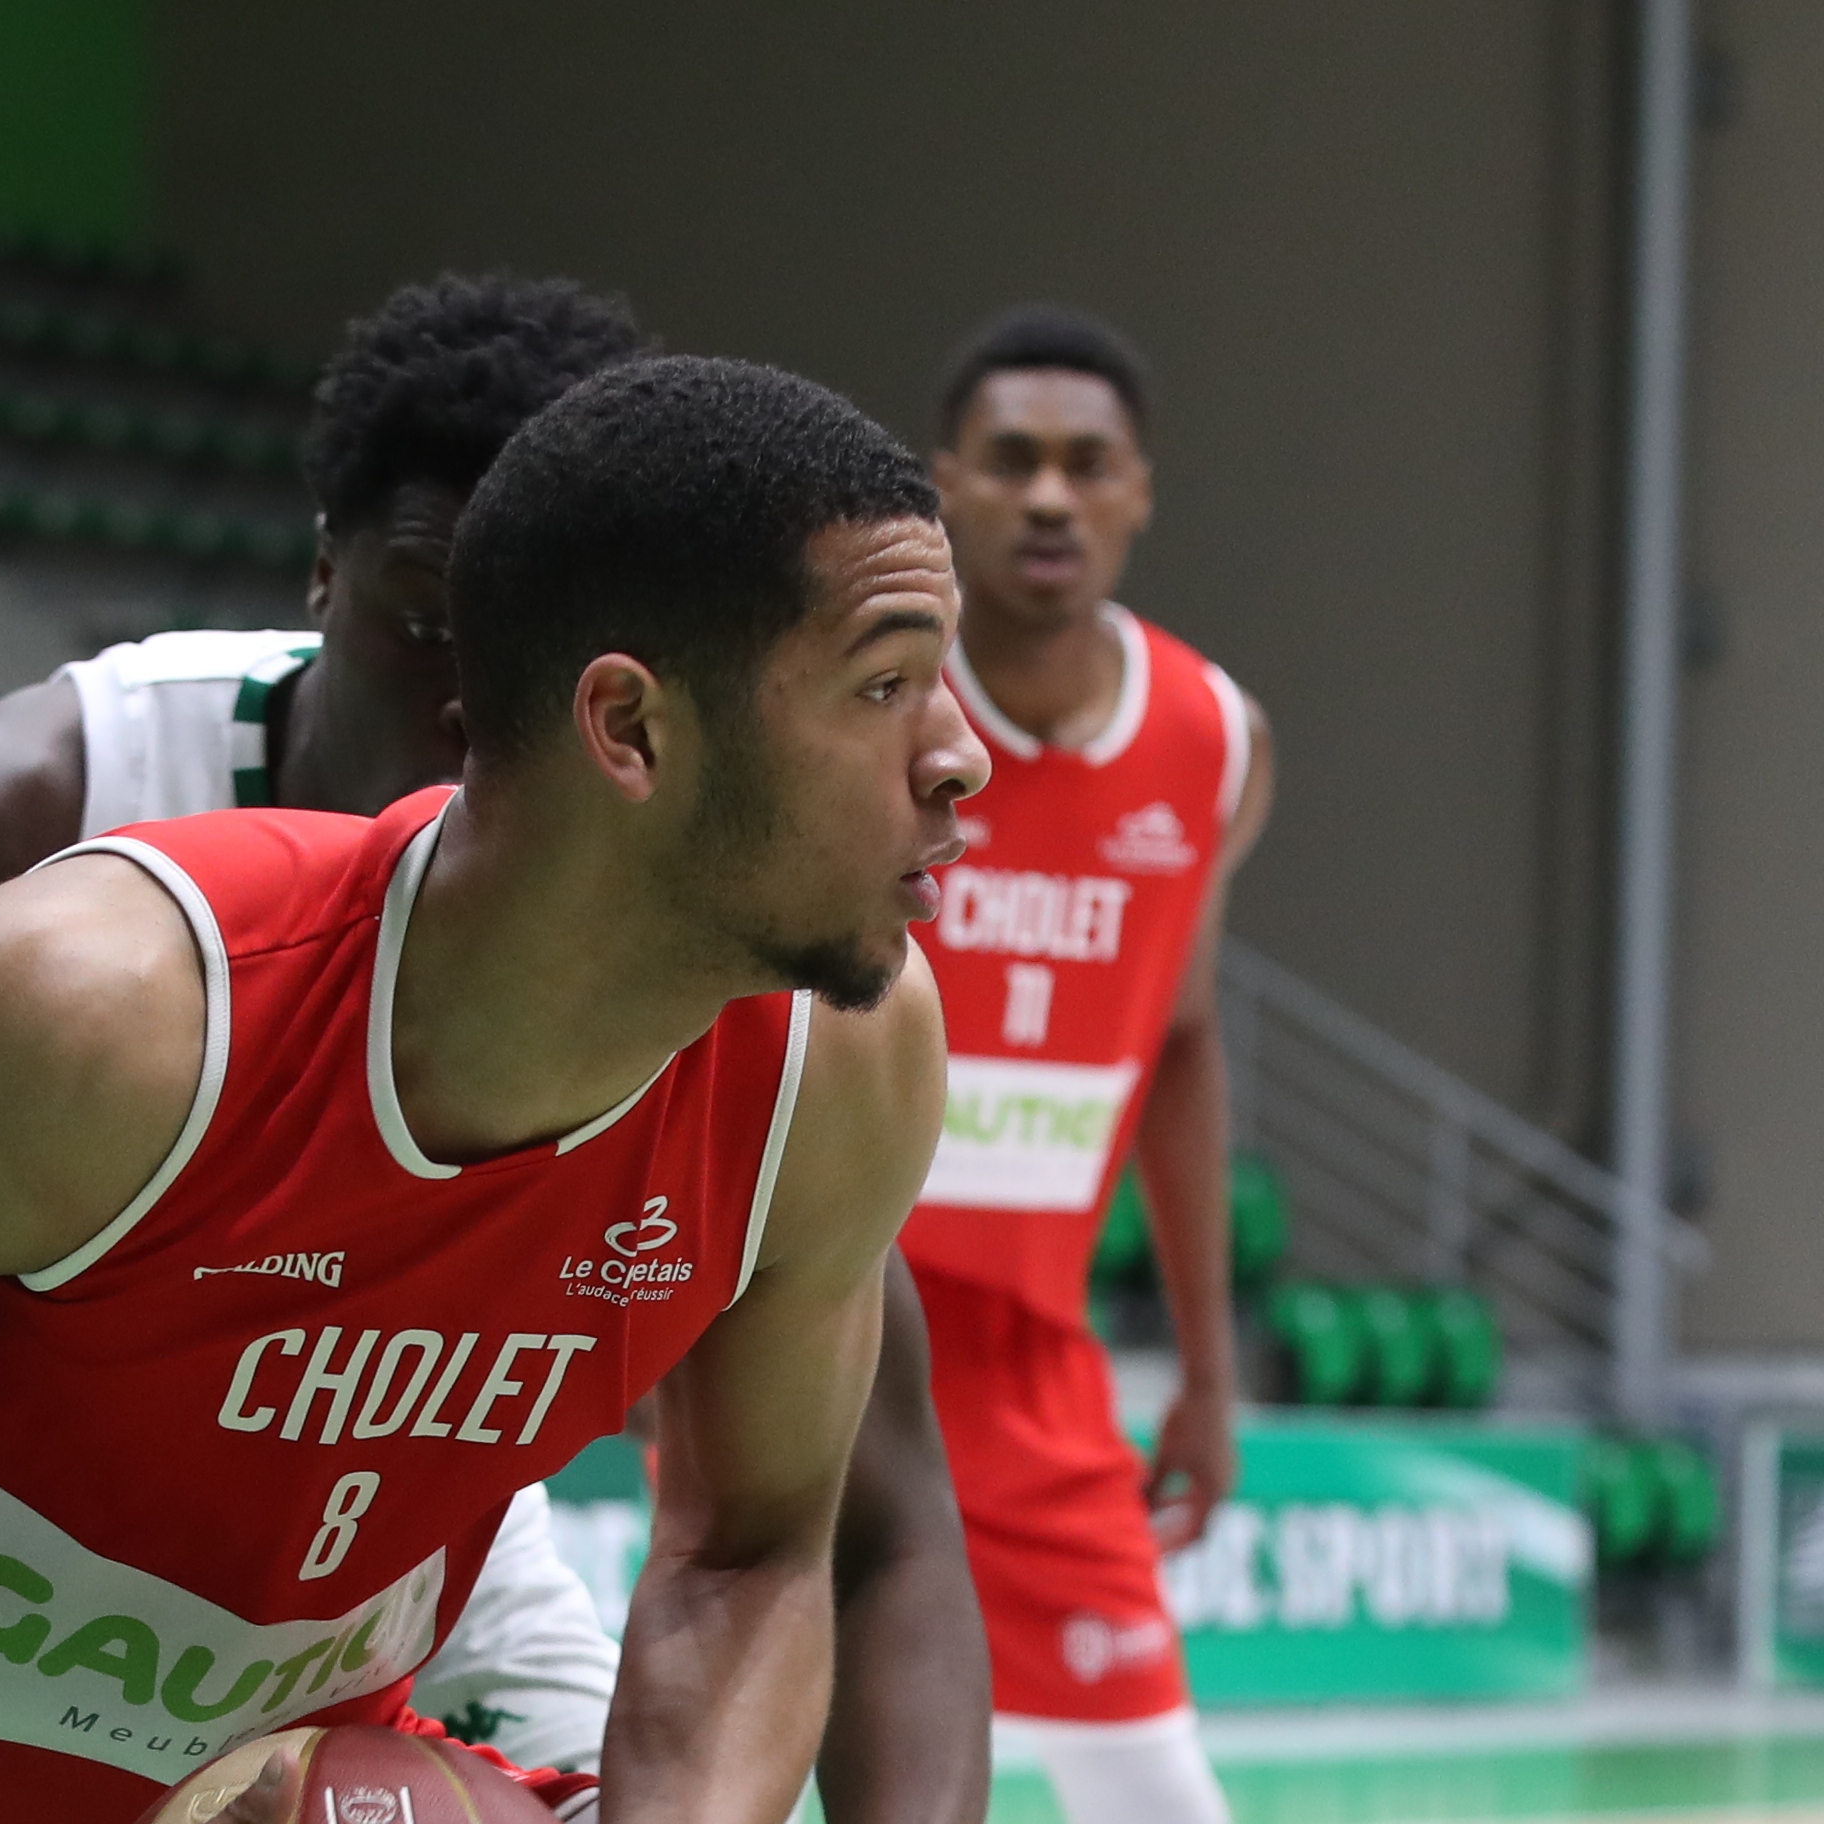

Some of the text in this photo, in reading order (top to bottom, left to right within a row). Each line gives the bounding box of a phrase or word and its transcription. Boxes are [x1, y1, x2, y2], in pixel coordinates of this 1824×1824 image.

[938, 865, 1131, 961] CHOLET
[559, 1256, 594, 1279] Le
[566, 1282, 674, 1307] L'audace réussir
[217, 1326, 597, 1445] CHOLET
[298, 1471, 380, 1581] 8
